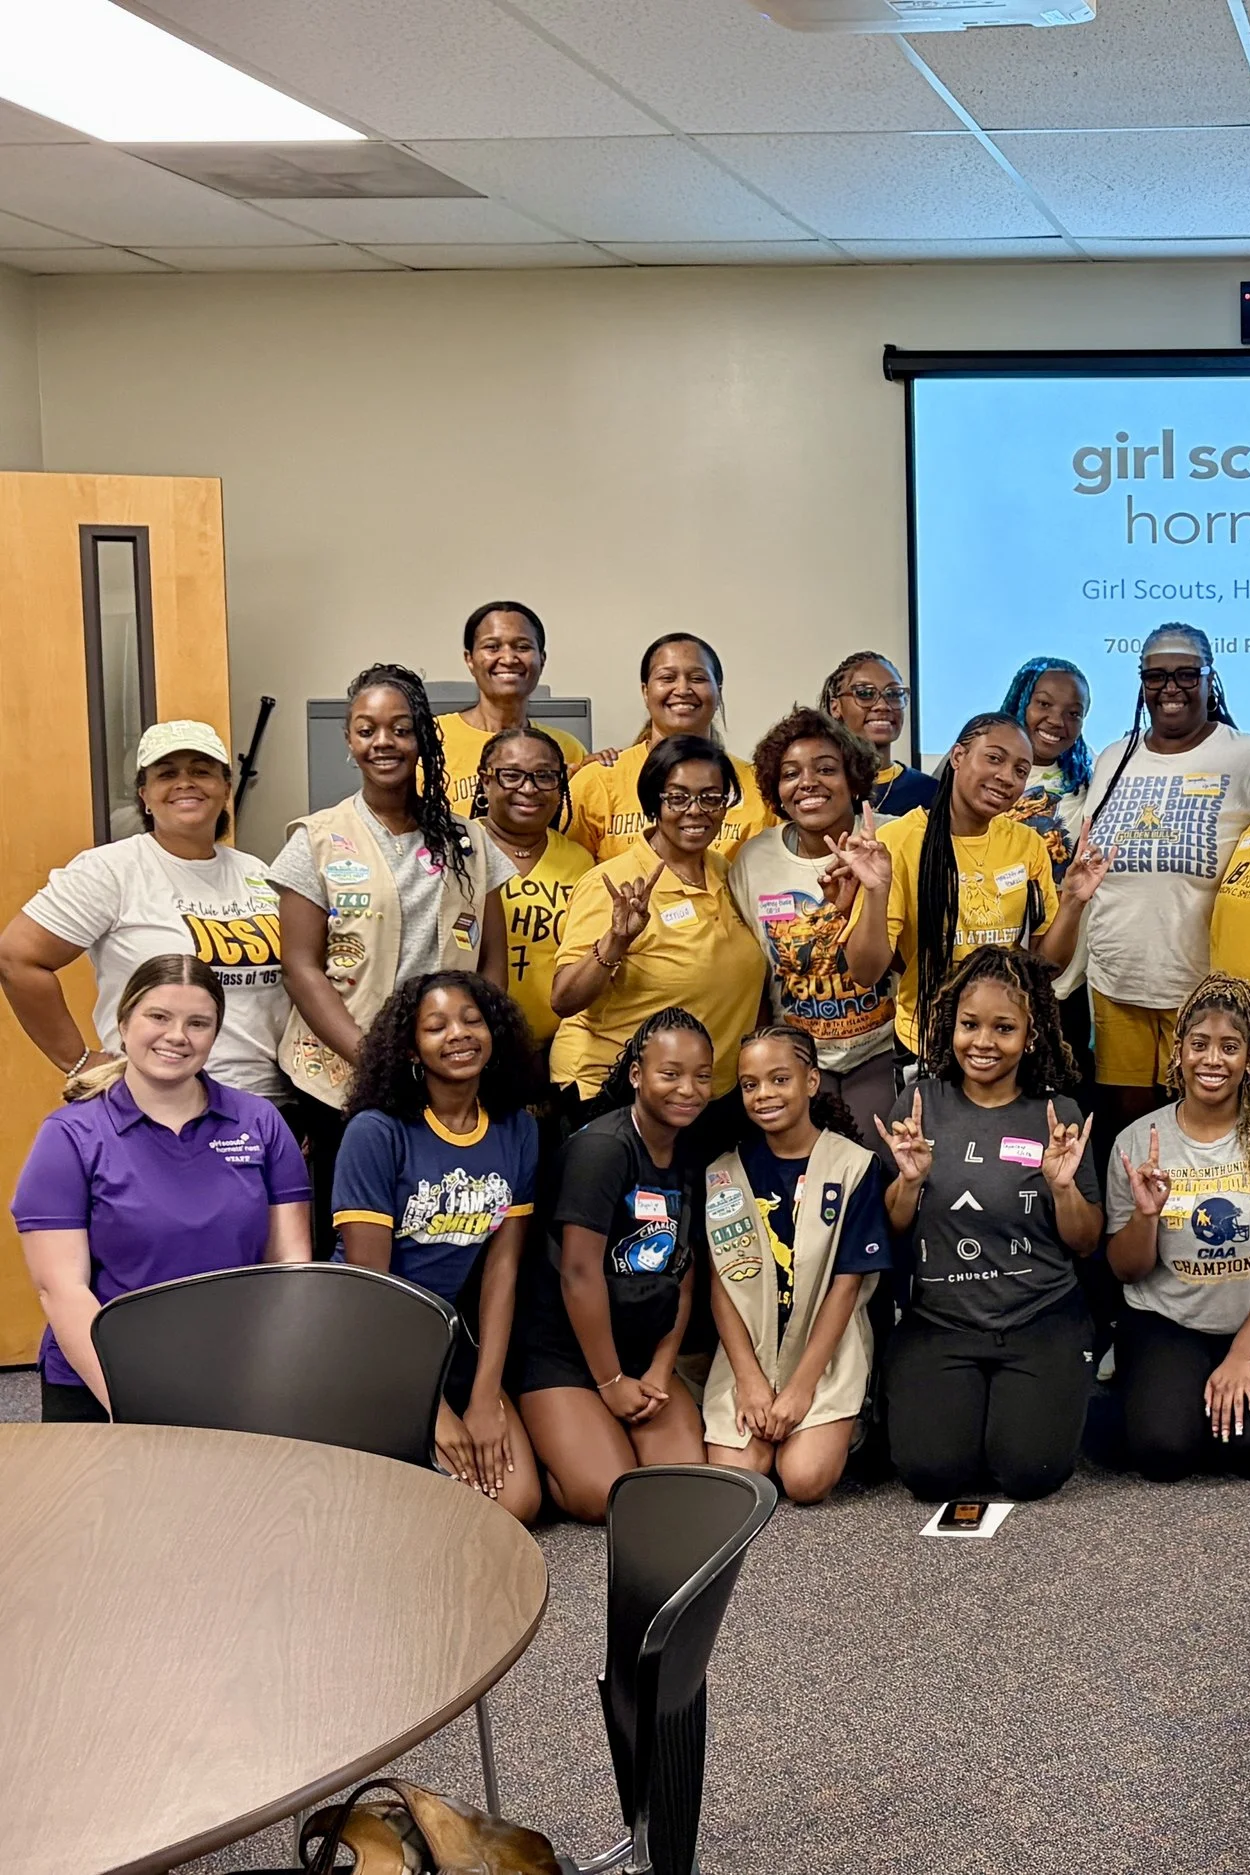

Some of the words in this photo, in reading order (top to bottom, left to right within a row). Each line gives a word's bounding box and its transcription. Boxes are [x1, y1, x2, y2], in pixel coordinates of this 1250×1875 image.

[1072, 429, 1175, 494] girl
[1082, 578, 1125, 600] Girl
[1134, 578, 1223, 603] Scouts,
[1104, 638, 1141, 654] 700
[1113, 776, 1167, 788] OLDEN
[1110, 788, 1164, 800] OLDEN
[1165, 799, 1223, 812] BULLS
[607, 812, 645, 834] JOHN
[1162, 811, 1220, 823] BULLS
[1099, 847, 1152, 859] LDEN
[1157, 846, 1219, 865] BULLS
[1107, 860, 1152, 873] LDEN
[1157, 860, 1217, 879] BULLS
[338, 894, 369, 906] 740
[511, 905, 566, 945] HBC
[245, 971, 257, 985] of
[1164, 1168, 1189, 1179] NSON
[1198, 1166, 1227, 1178] SMITH
[458, 1191, 485, 1214] AM
[639, 1221, 678, 1238] CHARLO
[1197, 1246, 1237, 1260] CIAA
[947, 1269, 999, 1283] CHURCH
